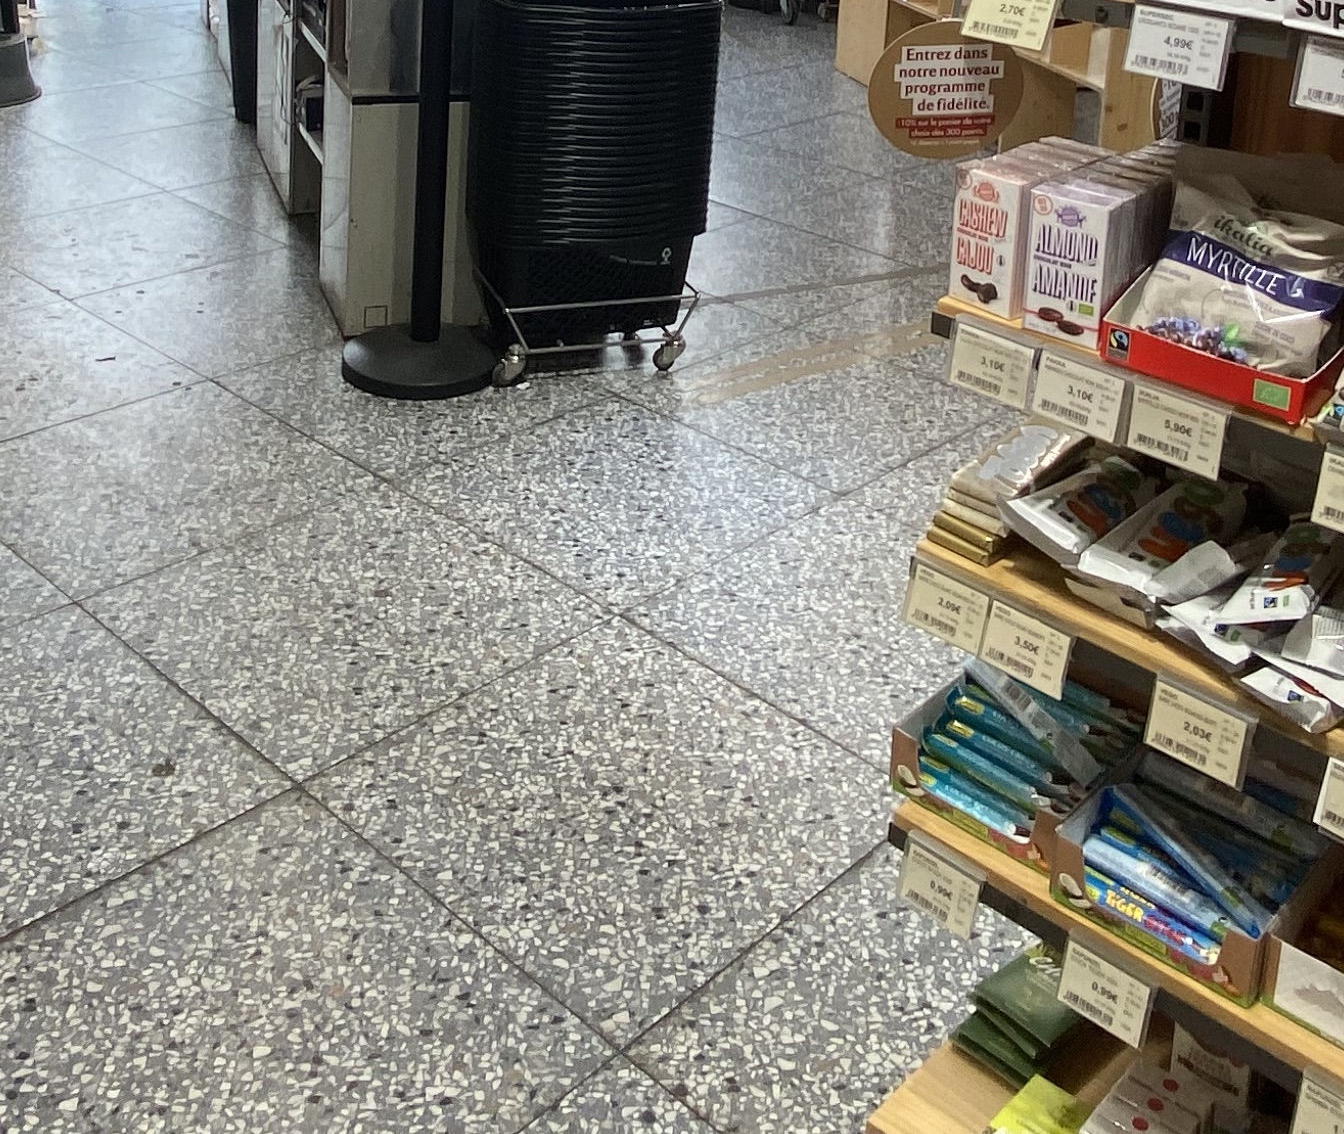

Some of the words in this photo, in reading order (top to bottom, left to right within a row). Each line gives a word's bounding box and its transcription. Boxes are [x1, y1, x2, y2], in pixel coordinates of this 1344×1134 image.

[1164, 34, 1194, 50] 4,99€
[906, 48, 951, 62] Entrez
[954, 46, 988, 60] dans
[899, 67, 937, 78] notre
[939, 65, 1000, 78] nouveau
[905, 81, 985, 96] programme
[917, 100, 934, 112] de
[936, 97, 991, 111] fidélité.
[1036, 223, 1099, 265] ALMOND
[956, 236, 995, 276] CAJOU
[1033, 264, 1098, 304] AMANDE
[980, 355, 1005, 372] 3,10€
[1067, 385, 1094, 404] 3,10€
[1164, 418, 1193, 439] 5,90€
